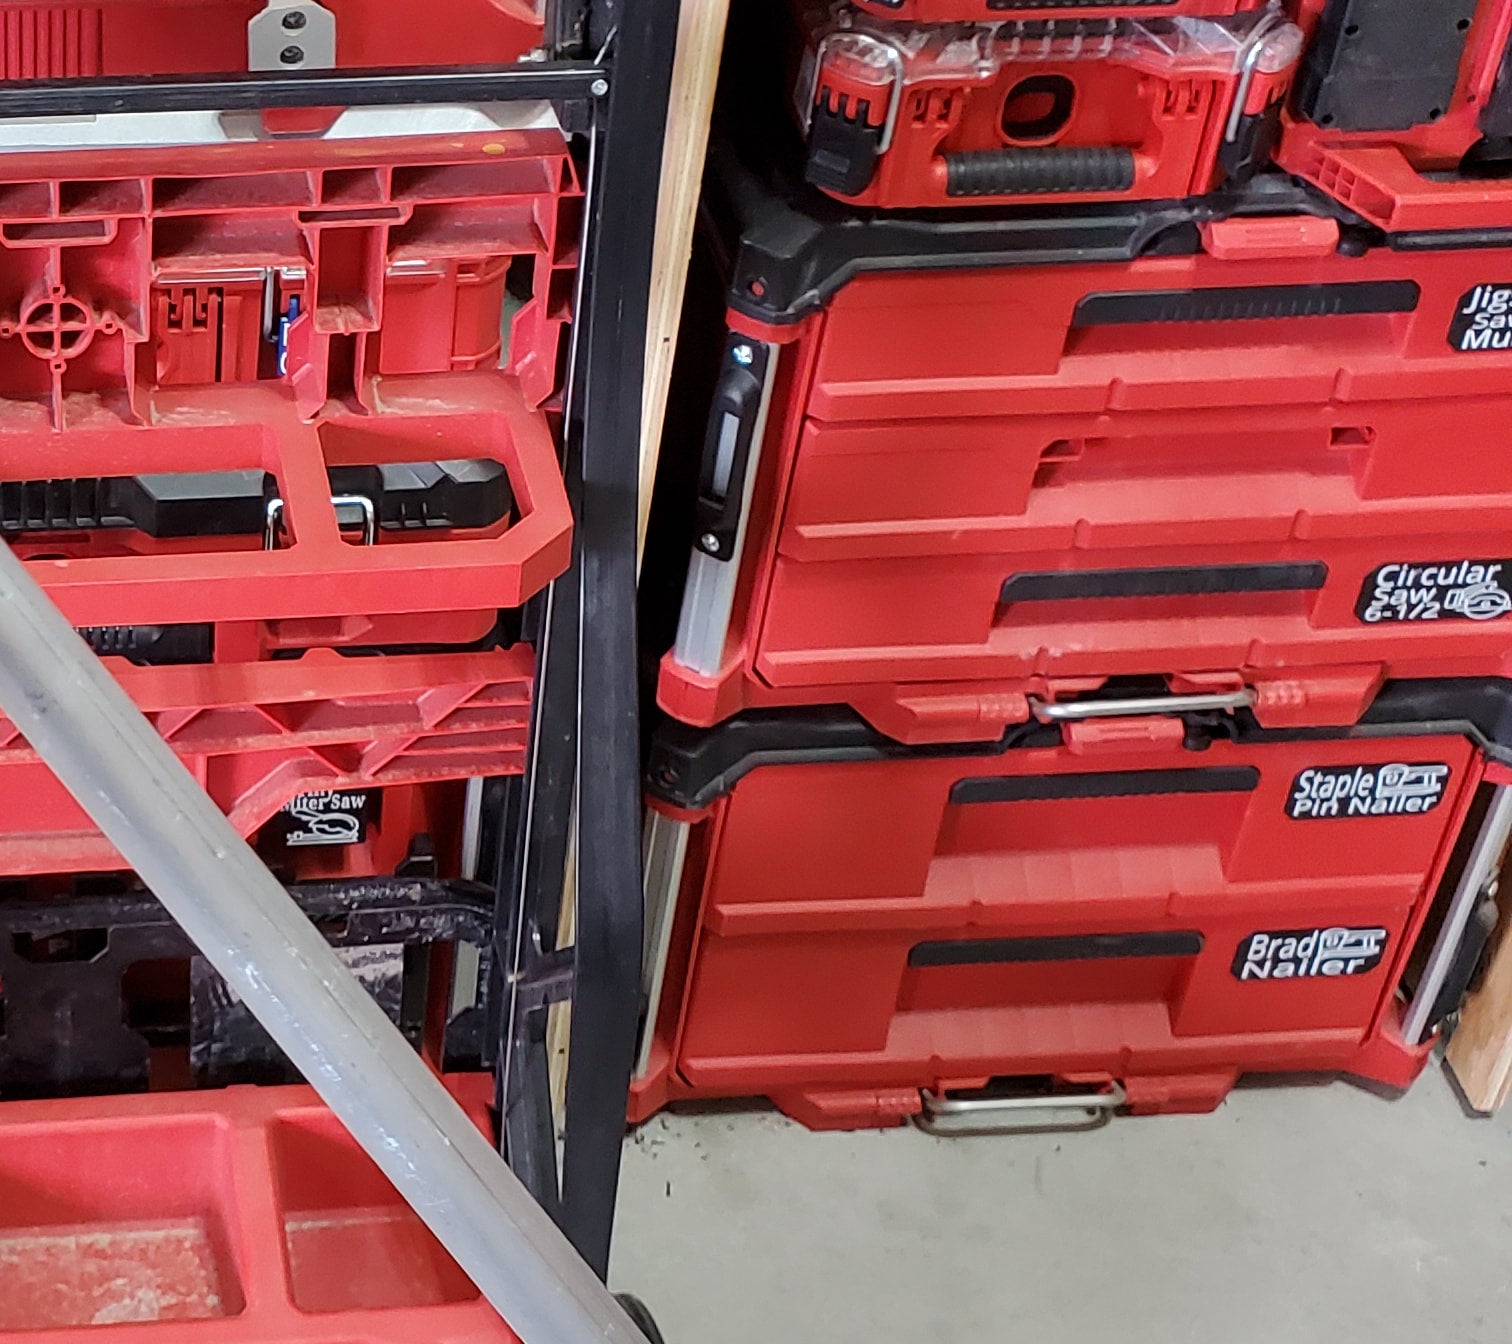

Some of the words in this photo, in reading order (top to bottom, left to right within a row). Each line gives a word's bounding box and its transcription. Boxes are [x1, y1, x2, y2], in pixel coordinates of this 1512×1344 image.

[1462, 285, 1512, 314] Jig
[1376, 559, 1502, 588] Circular
[1370, 586, 1437, 606] Saw
[1364, 601, 1441, 622] 6-1/2
[1293, 766, 1375, 801] Staple
[330, 793, 367, 810] Saw
[1347, 794, 1438, 815] Nailer
[1247, 929, 1320, 962] Brad
[1240, 956, 1366, 981] Nailer
